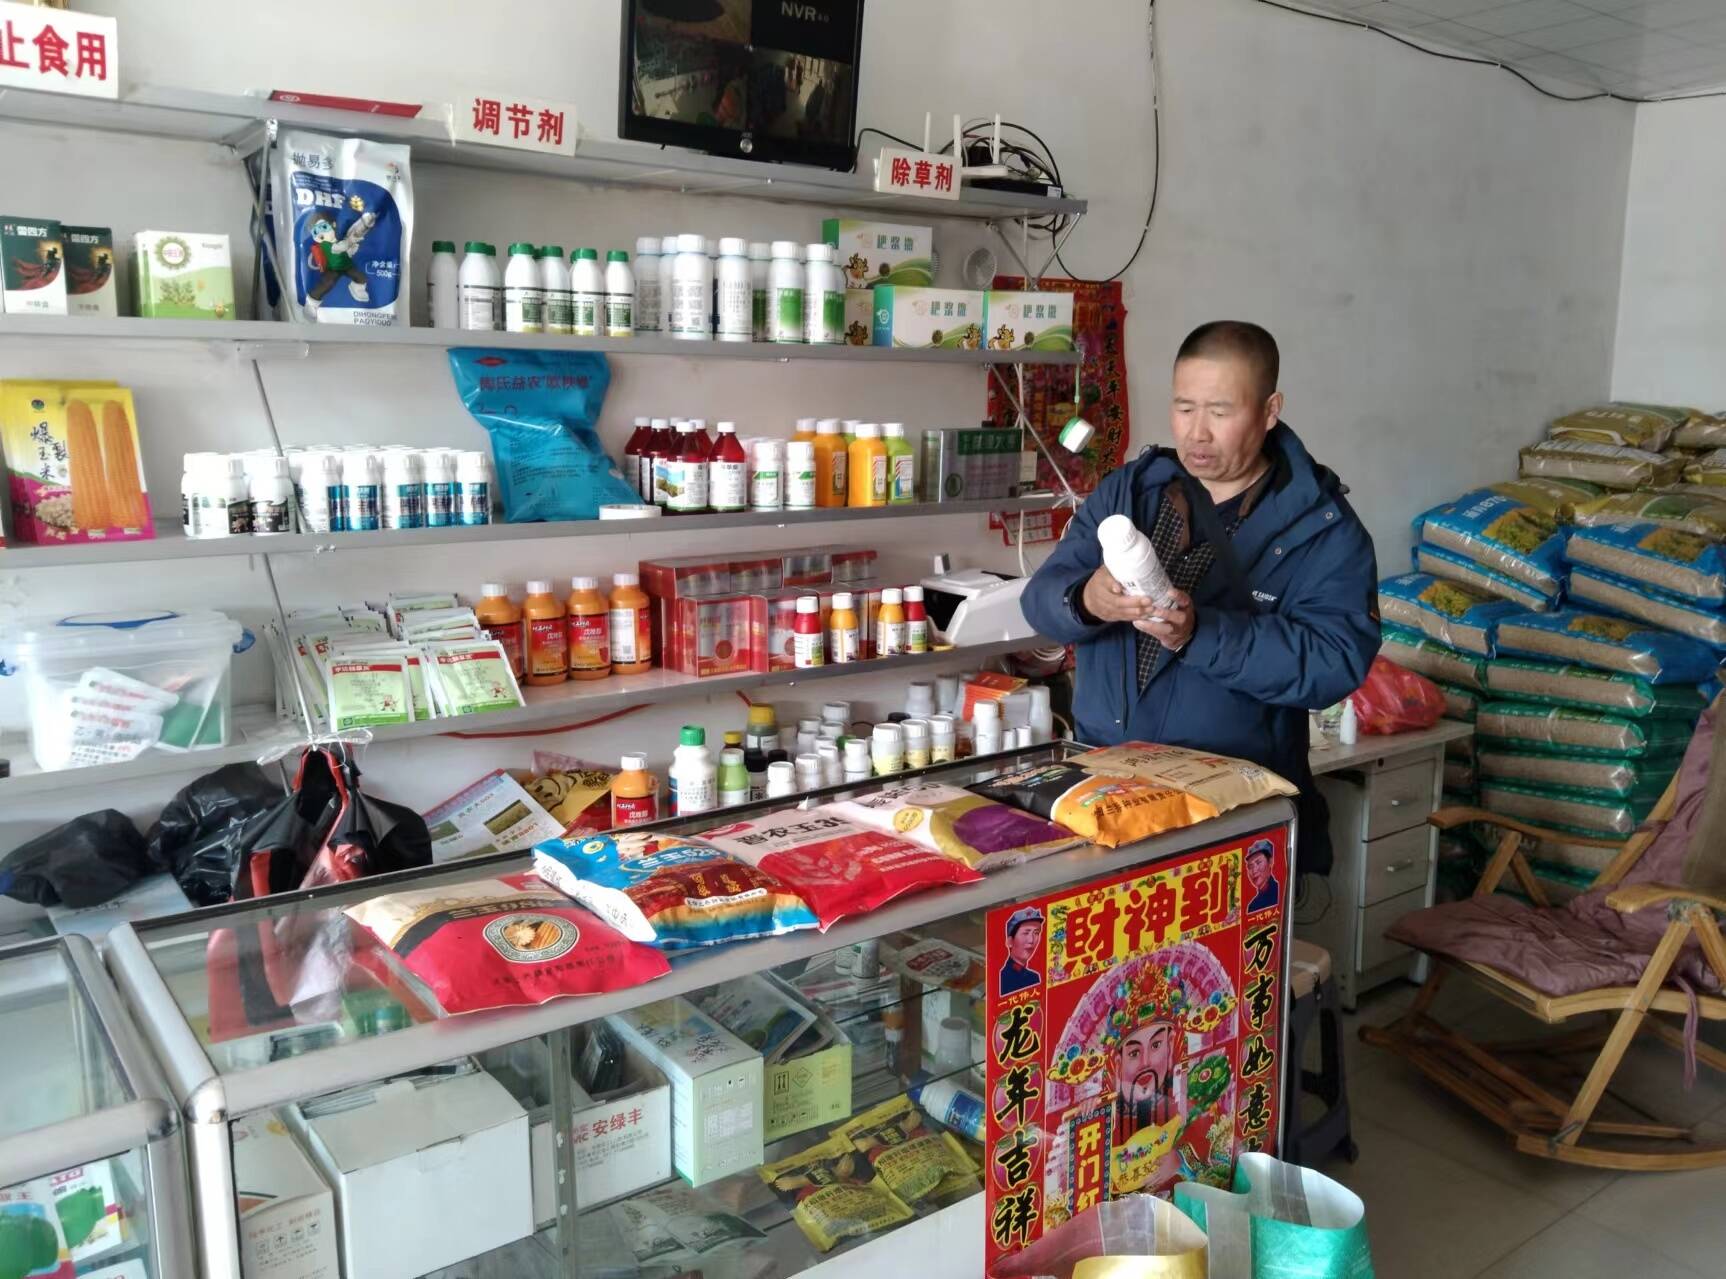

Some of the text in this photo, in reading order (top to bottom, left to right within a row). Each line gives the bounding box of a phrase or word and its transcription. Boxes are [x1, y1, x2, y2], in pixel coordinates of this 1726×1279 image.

[781, 0, 815, 21] NVR
[0, 20, 108, 82] 止食用
[472, 98, 564, 146] 调节剂
[891, 157, 953, 192] 除草剂
[1064, 864, 1230, 966] 財神到
[997, 989, 1041, 1007] 一代伟人
[592, 1108, 643, 1137] 安绿丰
[993, 1004, 1041, 1247] 龙年吉祥
